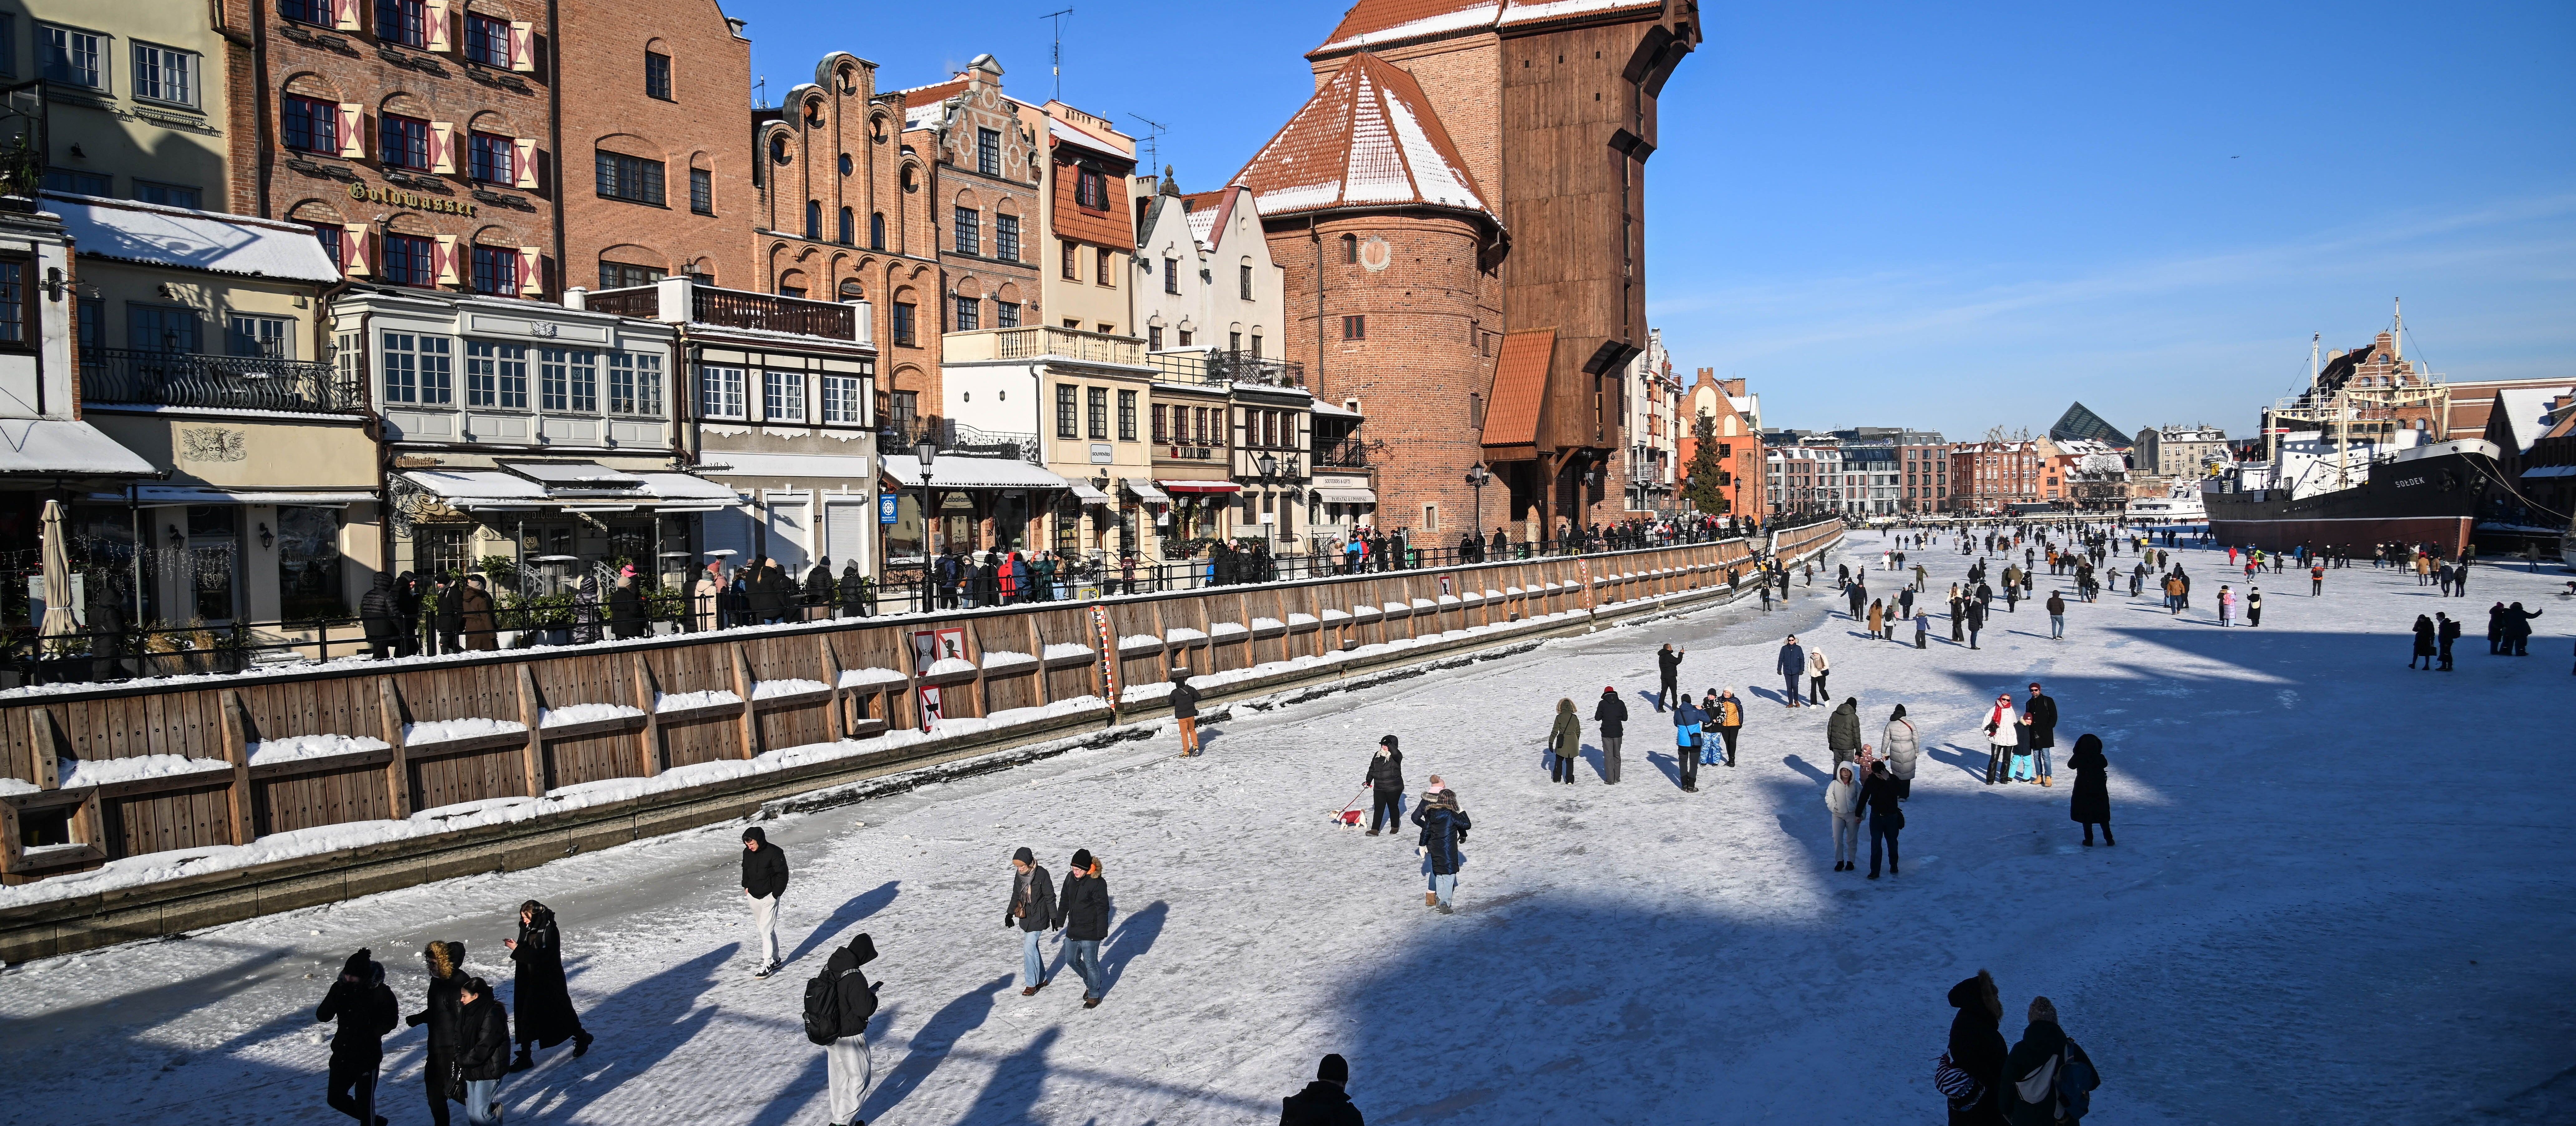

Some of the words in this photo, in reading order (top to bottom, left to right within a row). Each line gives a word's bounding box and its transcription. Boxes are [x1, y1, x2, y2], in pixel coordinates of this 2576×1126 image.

[348, 182, 474, 215] Goldwasser
[1181, 447, 1195, 459] SUSHI
[1197, 448, 1211, 460] SIEDEM
[395, 456, 437, 468] Goldwasser
[2395, 477, 2425, 488] SOŁDEK
[814, 515, 822, 523] 27
